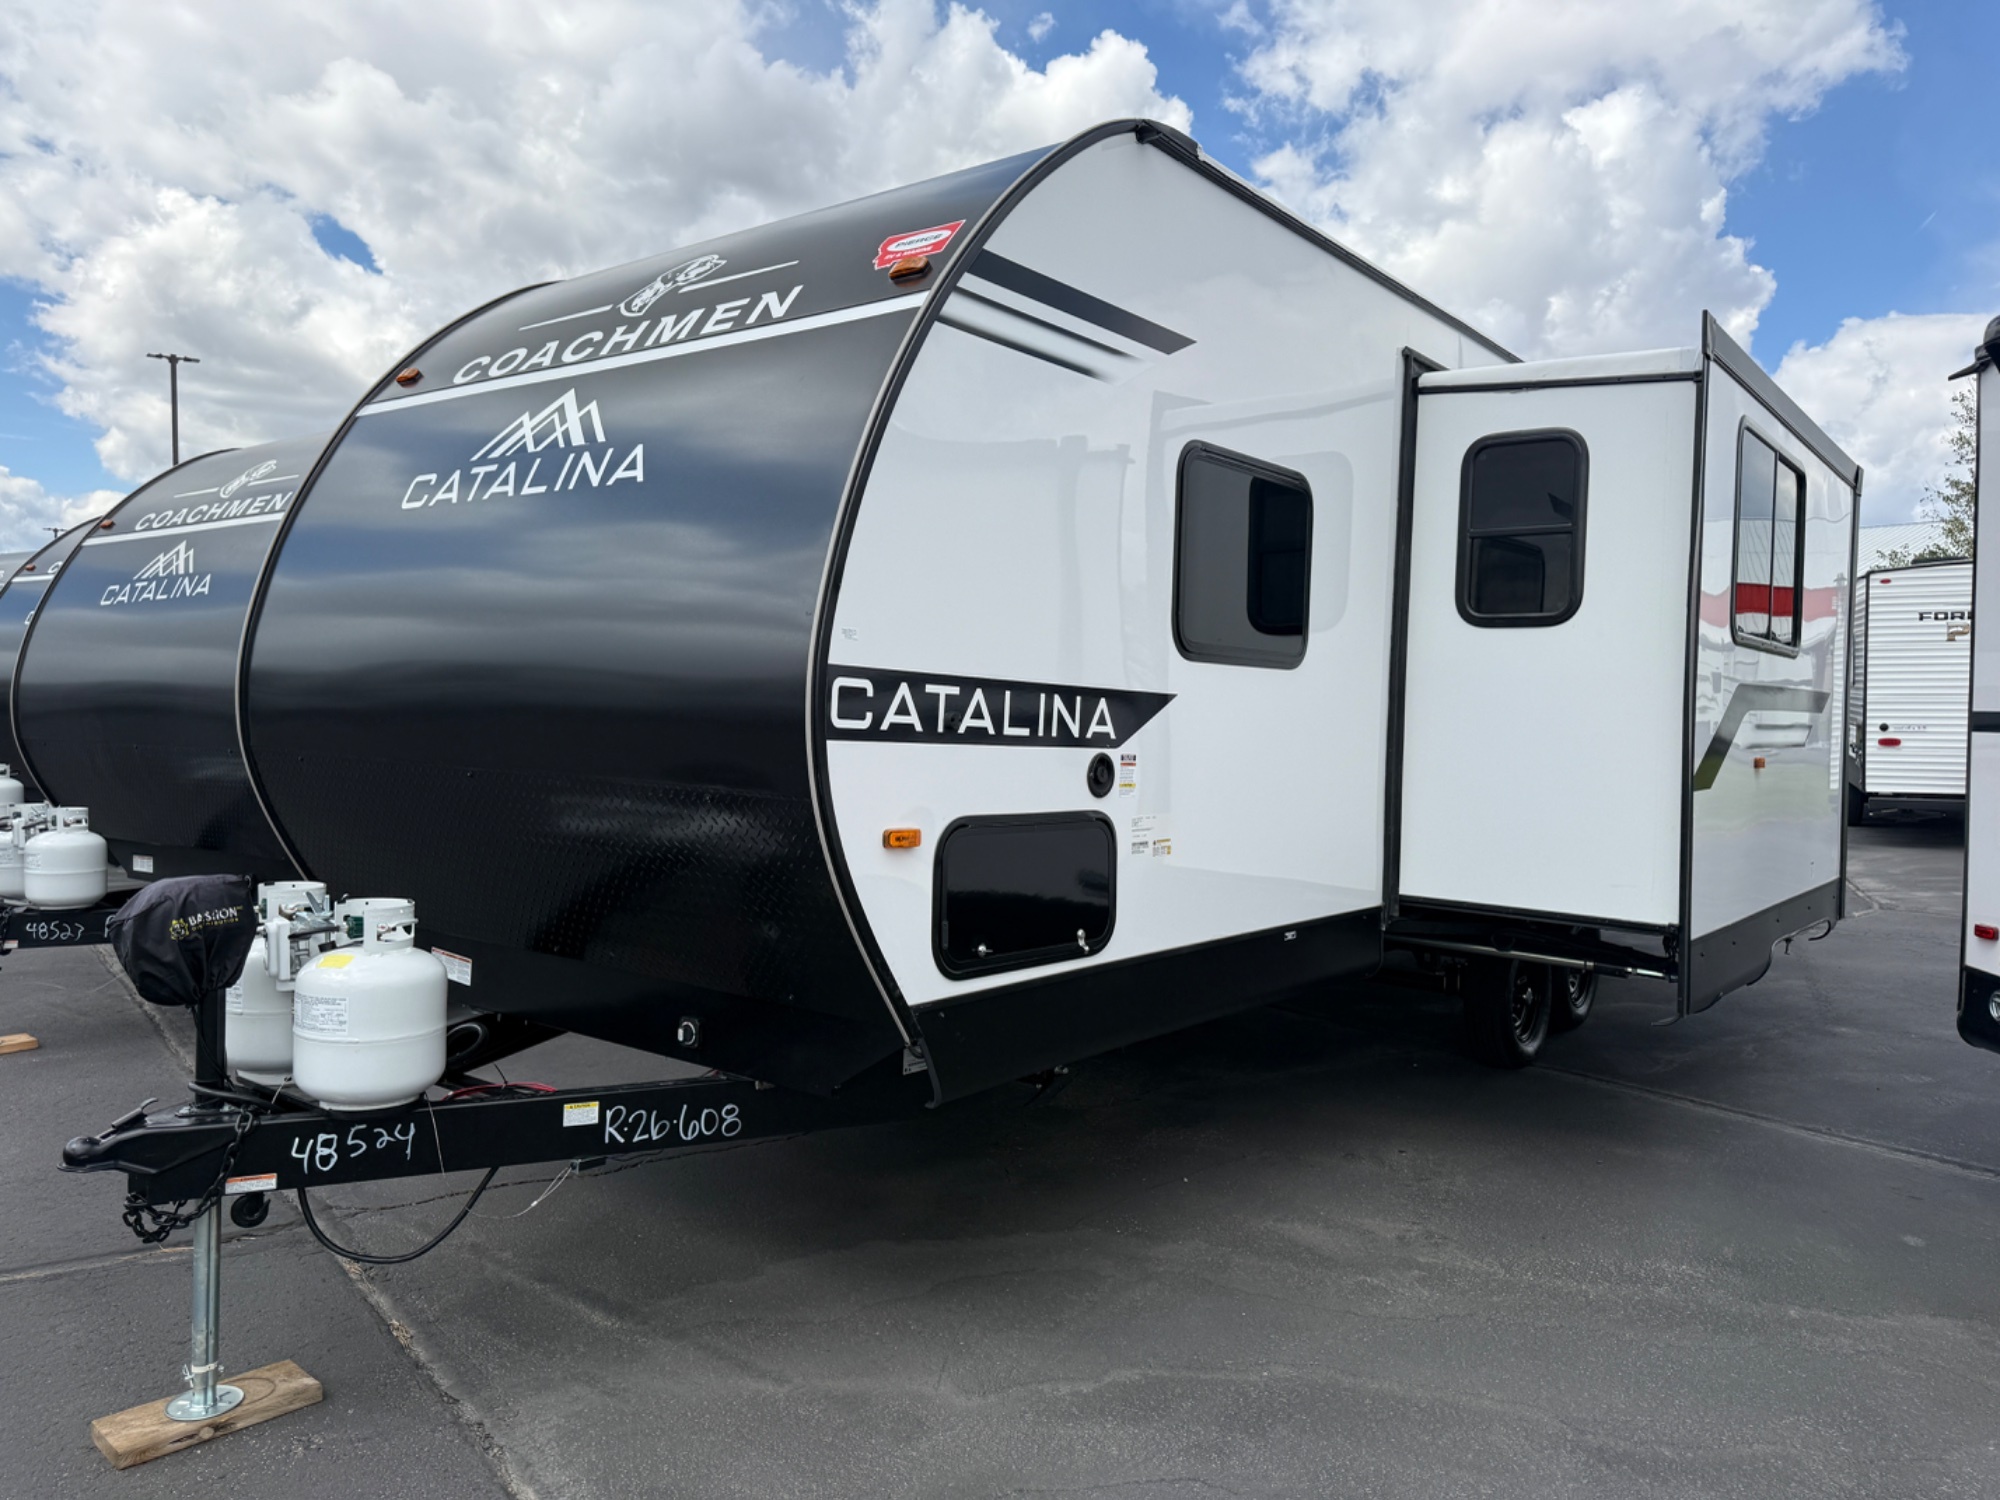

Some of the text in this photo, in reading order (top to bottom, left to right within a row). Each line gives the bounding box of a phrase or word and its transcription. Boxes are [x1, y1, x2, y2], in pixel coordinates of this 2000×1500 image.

[453, 285, 803, 384] COACHMEN
[401, 443, 645, 510] CATALINA
[135, 491, 293, 531] COACHMEN
[100, 574, 211, 606] CATALINA
[830, 677, 1117, 740] CATALINA
[291, 1122, 415, 1174] 48524
